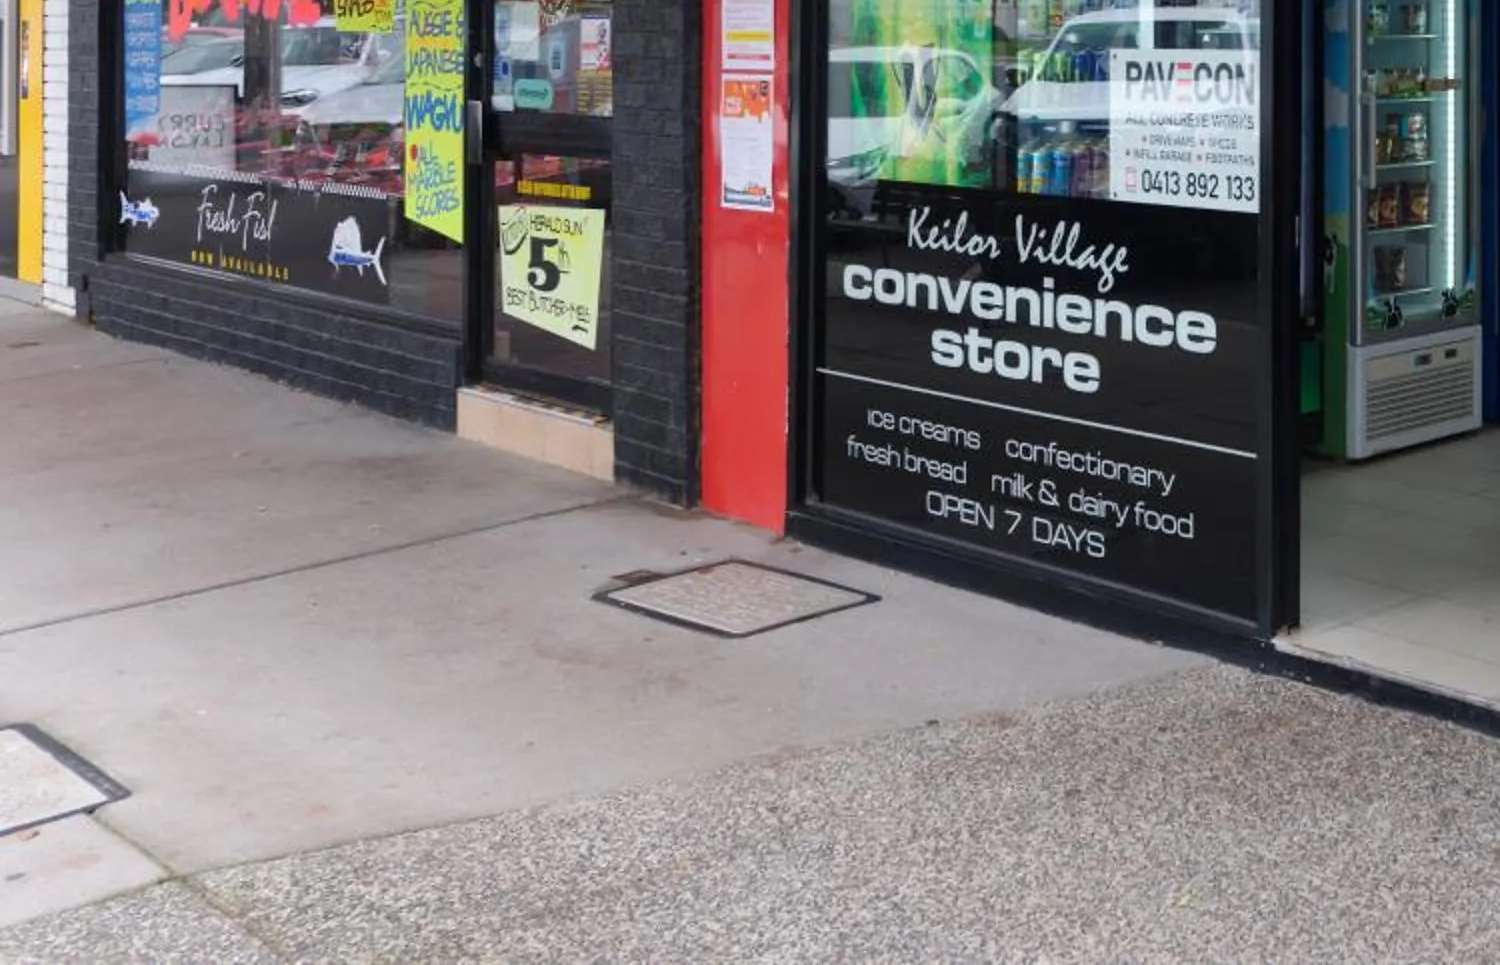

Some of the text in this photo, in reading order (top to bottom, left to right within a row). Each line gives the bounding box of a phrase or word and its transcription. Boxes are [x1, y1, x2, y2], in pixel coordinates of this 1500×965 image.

[196, 184, 241, 242] Fresh
[1141, 168, 1256, 202] 0413 892 133
[905, 205, 1130, 292] Keilor Village
[842, 263, 1218, 355] convenience
[930, 326, 1102, 394] store
[847, 434, 1195, 540] fresh bread milk & dairy food
[866, 408, 1176, 496] ice creams confectionary
[925, 489, 1106, 559] OPEN 7 DAYS
